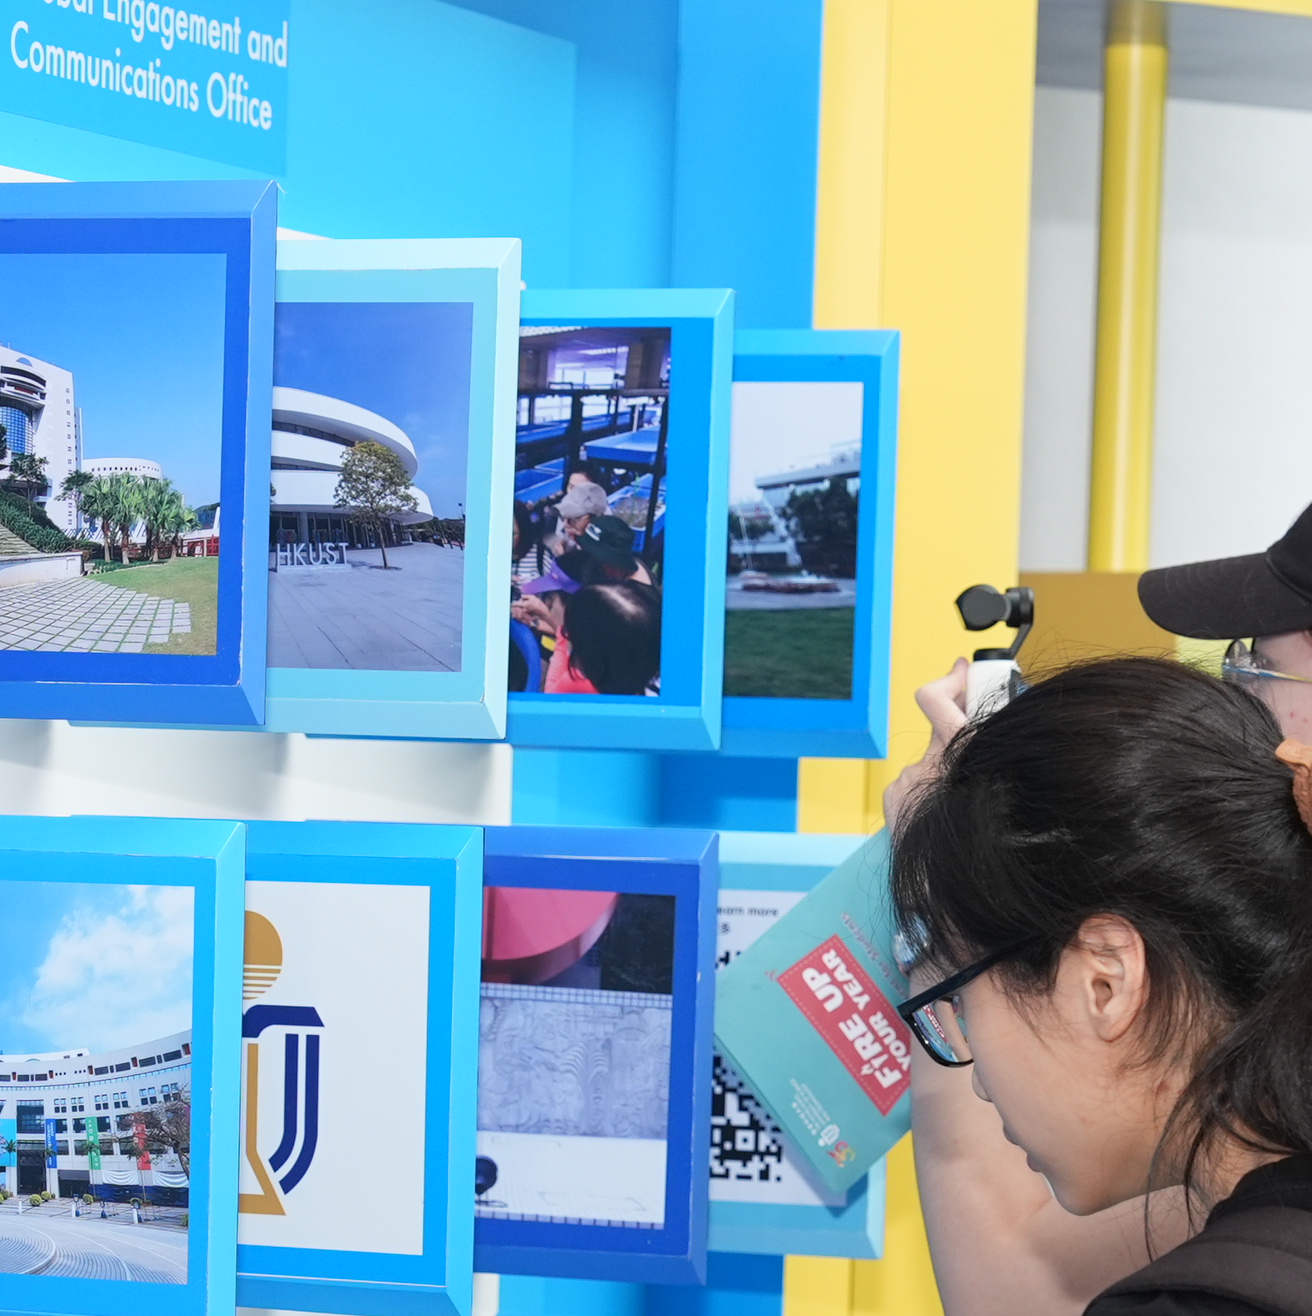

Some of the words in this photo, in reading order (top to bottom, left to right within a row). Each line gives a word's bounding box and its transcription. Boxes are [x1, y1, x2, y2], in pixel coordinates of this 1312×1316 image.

[103, 0, 242, 51] Engagement
[247, 20, 289, 68] and
[10, 19, 200, 113] Communications
[206, 71, 273, 131] Office
[276, 542, 349, 567] HKUST
[801, 966, 845, 1013] UP
[820, 948, 872, 1012] YEAR
[837, 1012, 904, 1090] FIRE
[867, 1010, 912, 1073] YOUR
